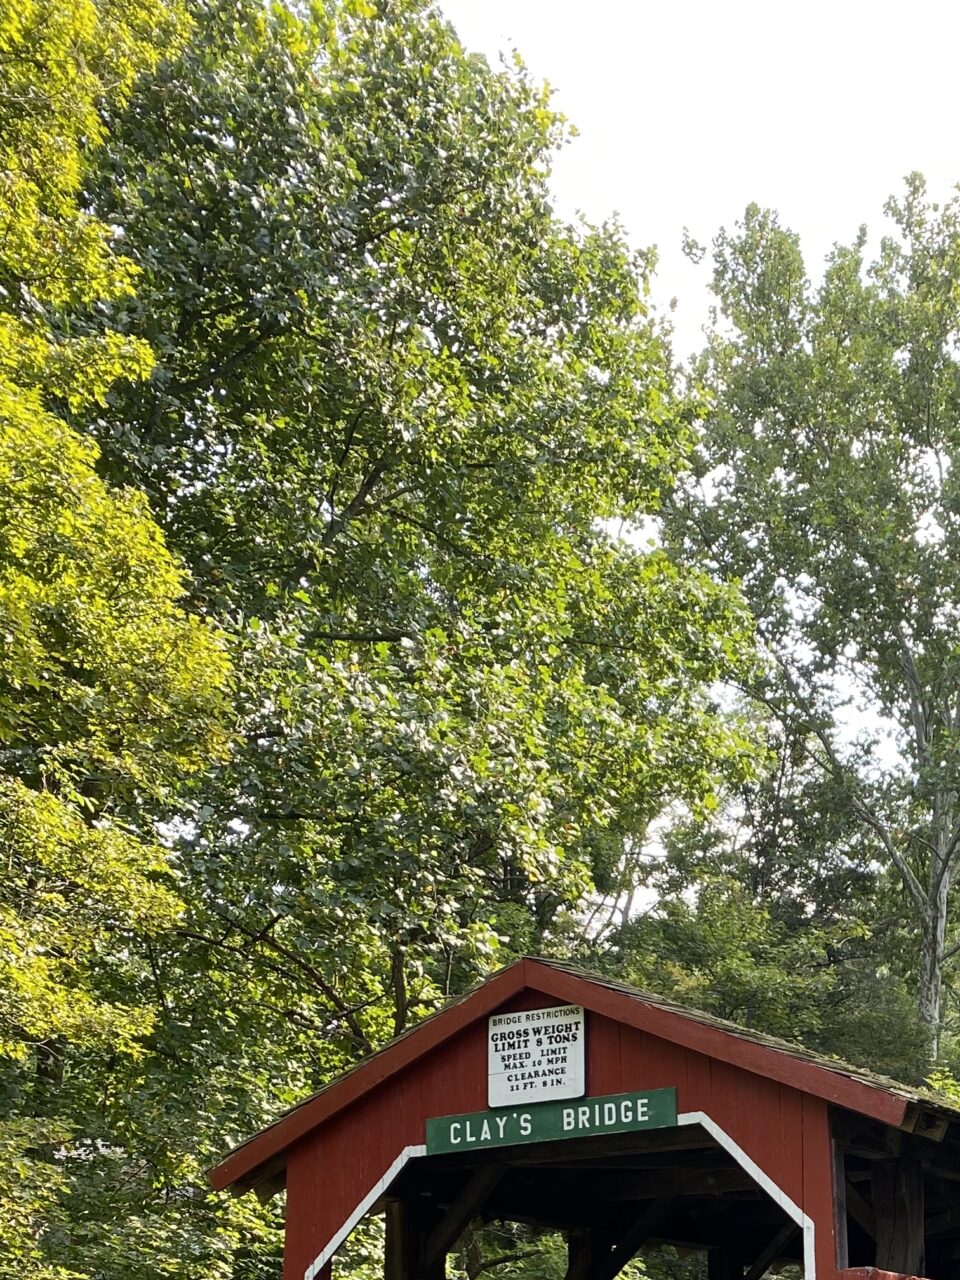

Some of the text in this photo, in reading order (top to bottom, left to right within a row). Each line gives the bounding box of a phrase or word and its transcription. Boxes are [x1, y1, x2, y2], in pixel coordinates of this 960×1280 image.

[492, 1007, 580, 1027] BRIDGE RESTRICTIONS
[491, 1022, 581, 1043] GROSS WEIGHT
[494, 1032, 578, 1052] LIMIT 8 TONS
[501, 1047, 567, 1062] SPEED LIMIT
[503, 1056, 567, 1070] MAX. 10 MPH
[507, 1067, 566, 1082] CLEARANCE
[523, 1082, 537, 1090] FT.
[550, 1078, 565, 1086] IN.
[450, 1099, 649, 1144] CLAY'S BRIDGE
